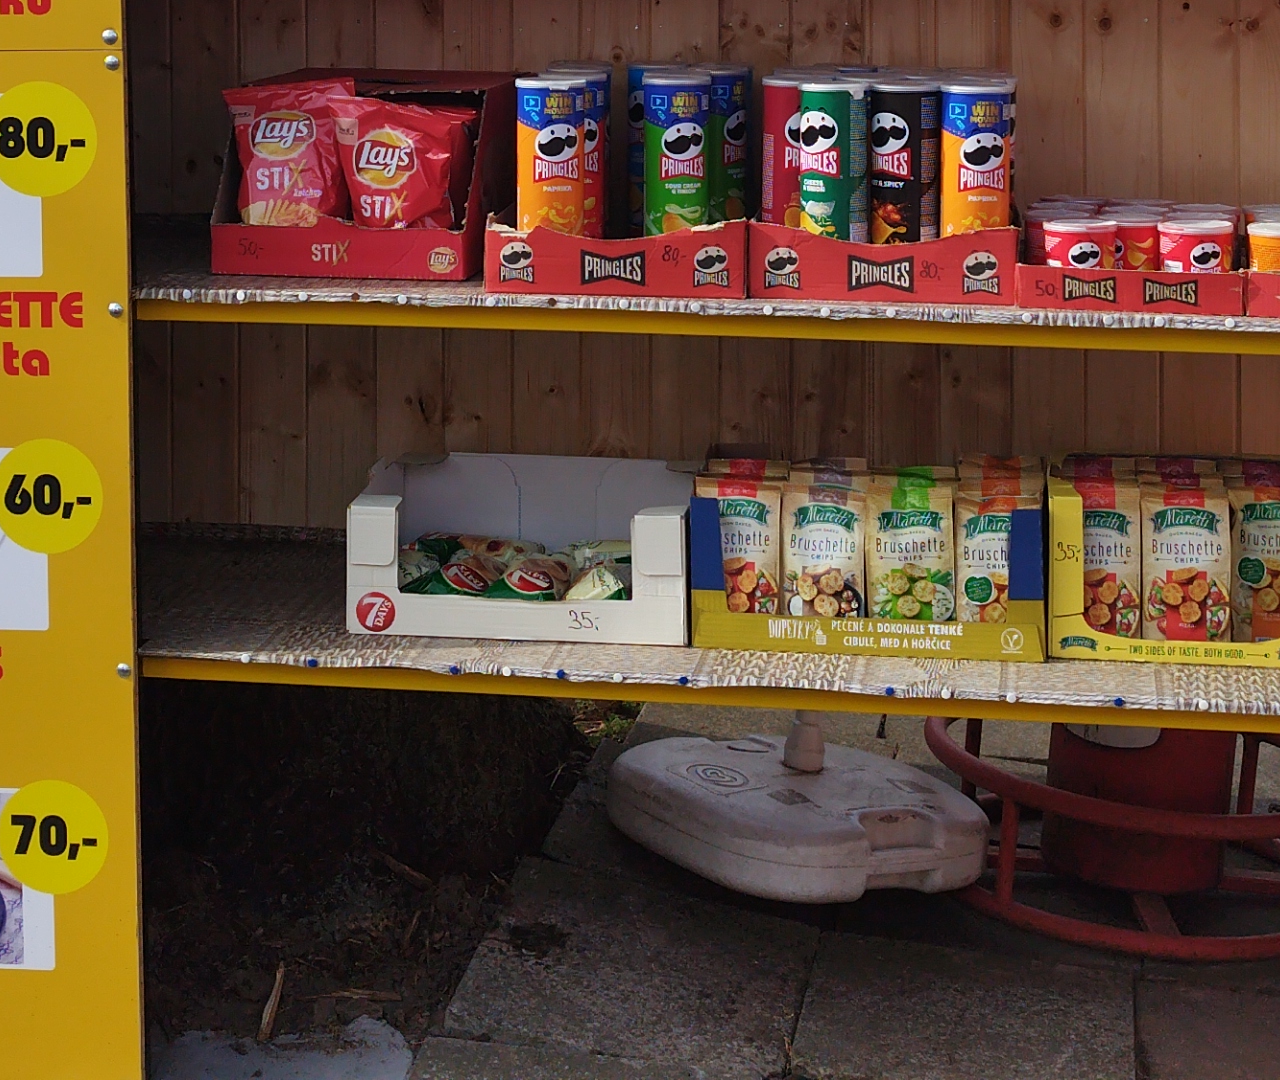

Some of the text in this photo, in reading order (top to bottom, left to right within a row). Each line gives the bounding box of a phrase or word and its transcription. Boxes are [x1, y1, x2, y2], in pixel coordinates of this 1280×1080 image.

[254, 118, 310, 149] Lay's
[358, 141, 411, 178] Lay's
[535, 158, 578, 180] PRINGLES
[661, 156, 703, 178] PRINGLES
[256, 159, 307, 196] STIX
[960, 168, 1004, 190] PRINGLES
[360, 190, 407, 225] STIX
[311, 240, 351, 266] STIX
[500, 266, 533, 281] PRINGLES
[584, 256, 641, 281] PRINGLES
[695, 271, 728, 286] PRINGLES
[851, 260, 909, 287] PRINGLES
[765, 272, 799, 288] PRINGLES
[964, 278, 998, 293] PRINGLES
[1065, 277, 1114, 300] PRINGLES
[1145, 282, 1195, 303] PRINGLES
[4, 473, 93, 520] 60,-
[801, 506, 851, 525] Maretti
[884, 511, 935, 530] Maretti
[1162, 509, 1211, 528] Maretti
[790, 533, 856, 553] Bruschette
[876, 537, 945, 553] Bruschette
[1152, 539, 1222, 556] Bruschette
[360, 596, 384, 628] 7
[374, 599, 394, 628] DAYS
[831, 619, 963, 636] PEČENÉ A DOKONALE TENKÉ
[843, 636, 951, 650] CIBULE, MED A HOŘČICE
[1129, 645, 1143, 655] TWO
[1145, 645, 1165, 656] SIDES
[1167, 646, 1177, 656] OF
[1204, 648, 1223, 658] BOTH
[10, 814, 98, 861] 70,-
